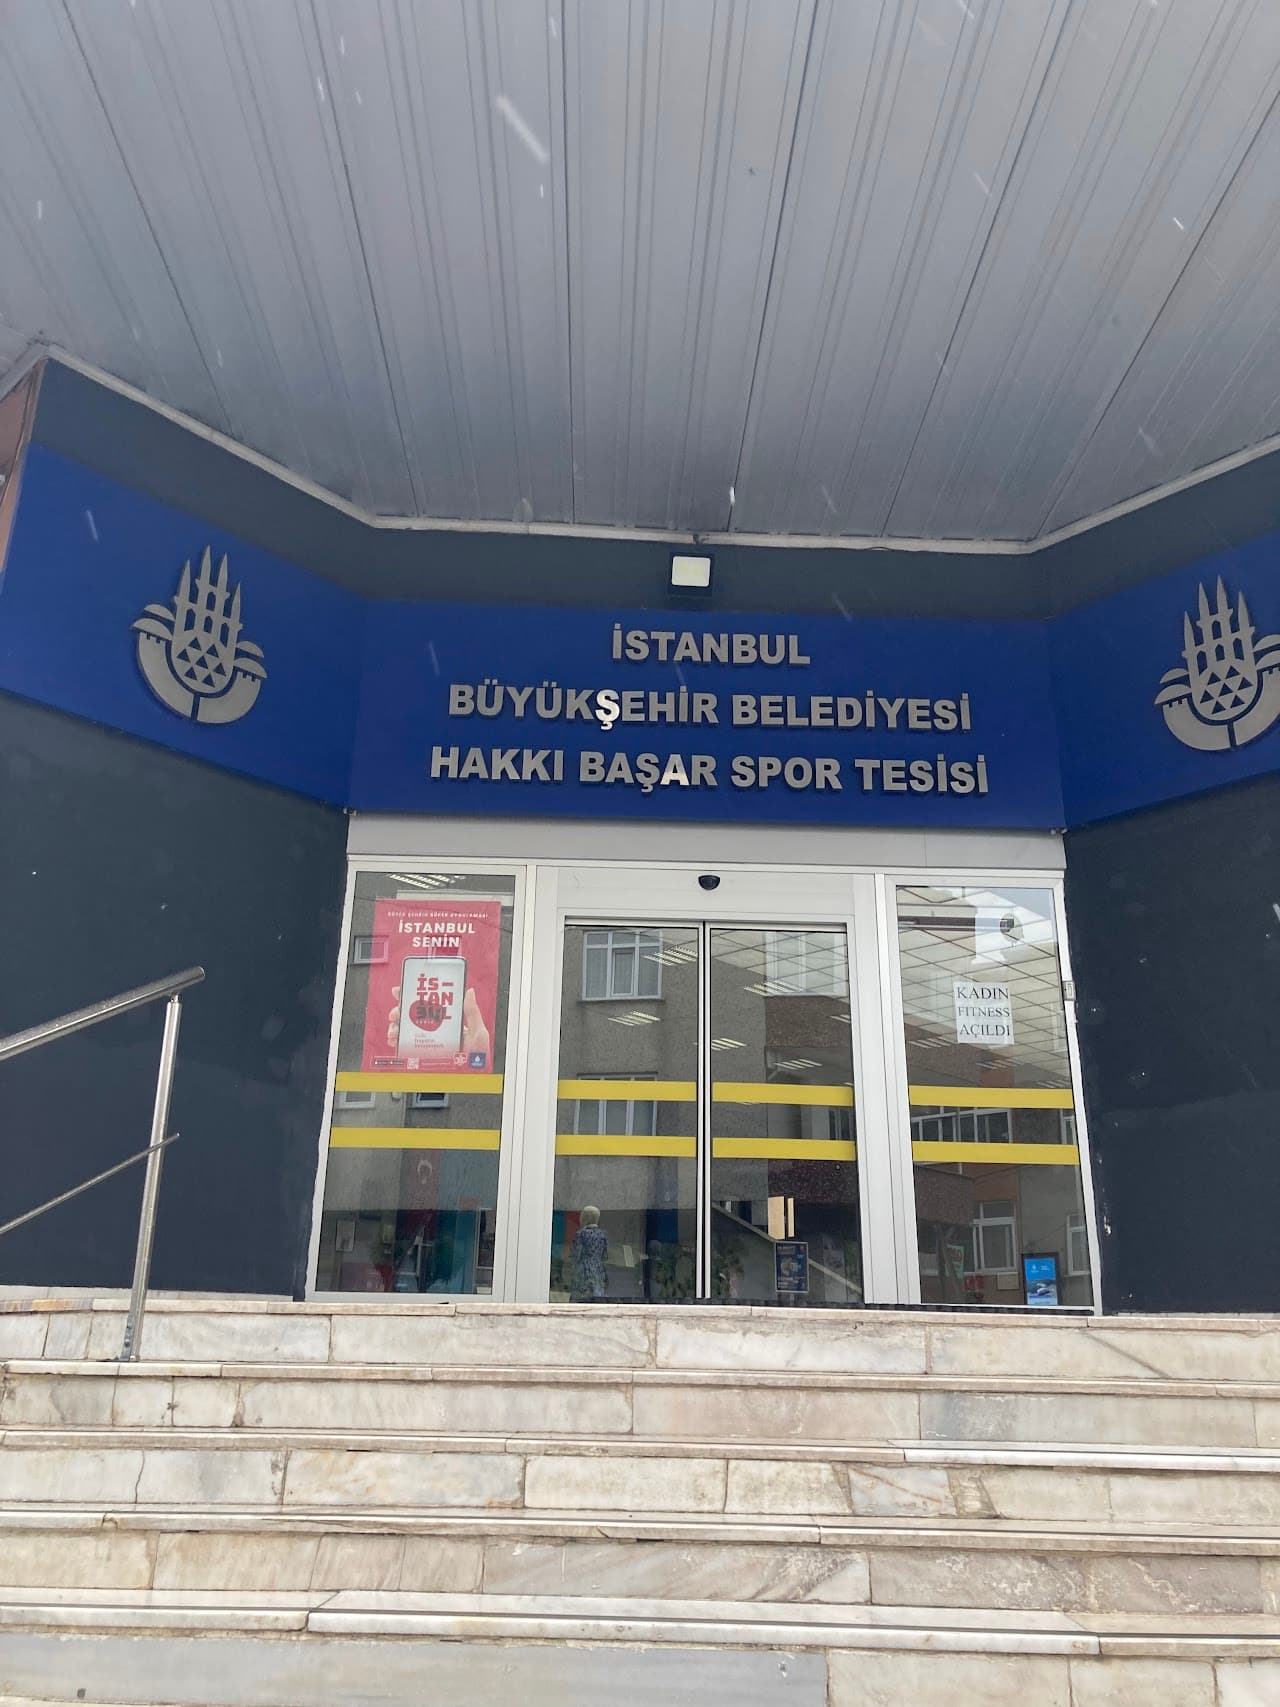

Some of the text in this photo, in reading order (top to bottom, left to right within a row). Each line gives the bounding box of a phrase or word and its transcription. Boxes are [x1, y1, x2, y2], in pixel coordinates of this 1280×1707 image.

[612, 623, 811, 664] İSTANBUL
[449, 678, 971, 731] BÜYÜKŞEHİR BELEDİYESİ
[430, 746, 988, 794] HAKKI BAŞAR SPOR TESİSİ
[398, 919, 476, 934] İSTANBUL
[412, 934, 460, 948] SENİN
[957, 987, 1009, 1000] KADIN
[958, 1006, 1010, 1017] FITNESS
[960, 1023, 1010, 1038] AÇILDI
